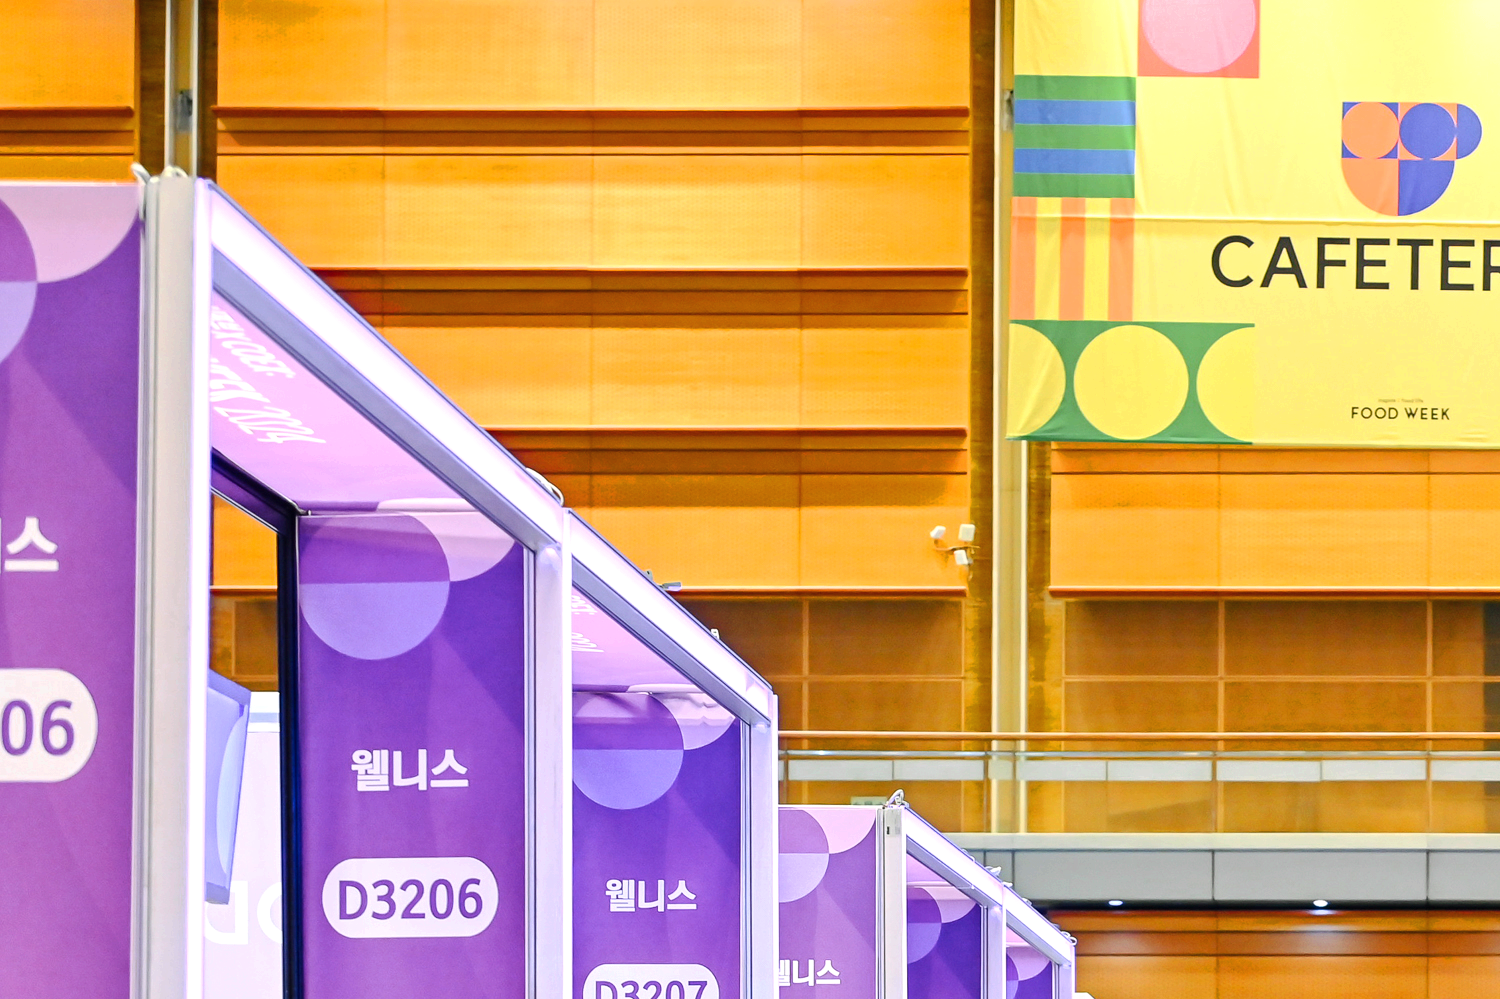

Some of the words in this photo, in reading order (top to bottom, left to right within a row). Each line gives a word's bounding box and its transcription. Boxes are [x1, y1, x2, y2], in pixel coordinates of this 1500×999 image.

[1351, 406, 1399, 420] FOOD
[1404, 407, 1450, 421] WEEK
[0, 516, 59, 572] 스
[350, 748, 469, 792] 웰니스
[337, 879, 483, 920] D3206
[605, 879, 697, 912] 웰니스
